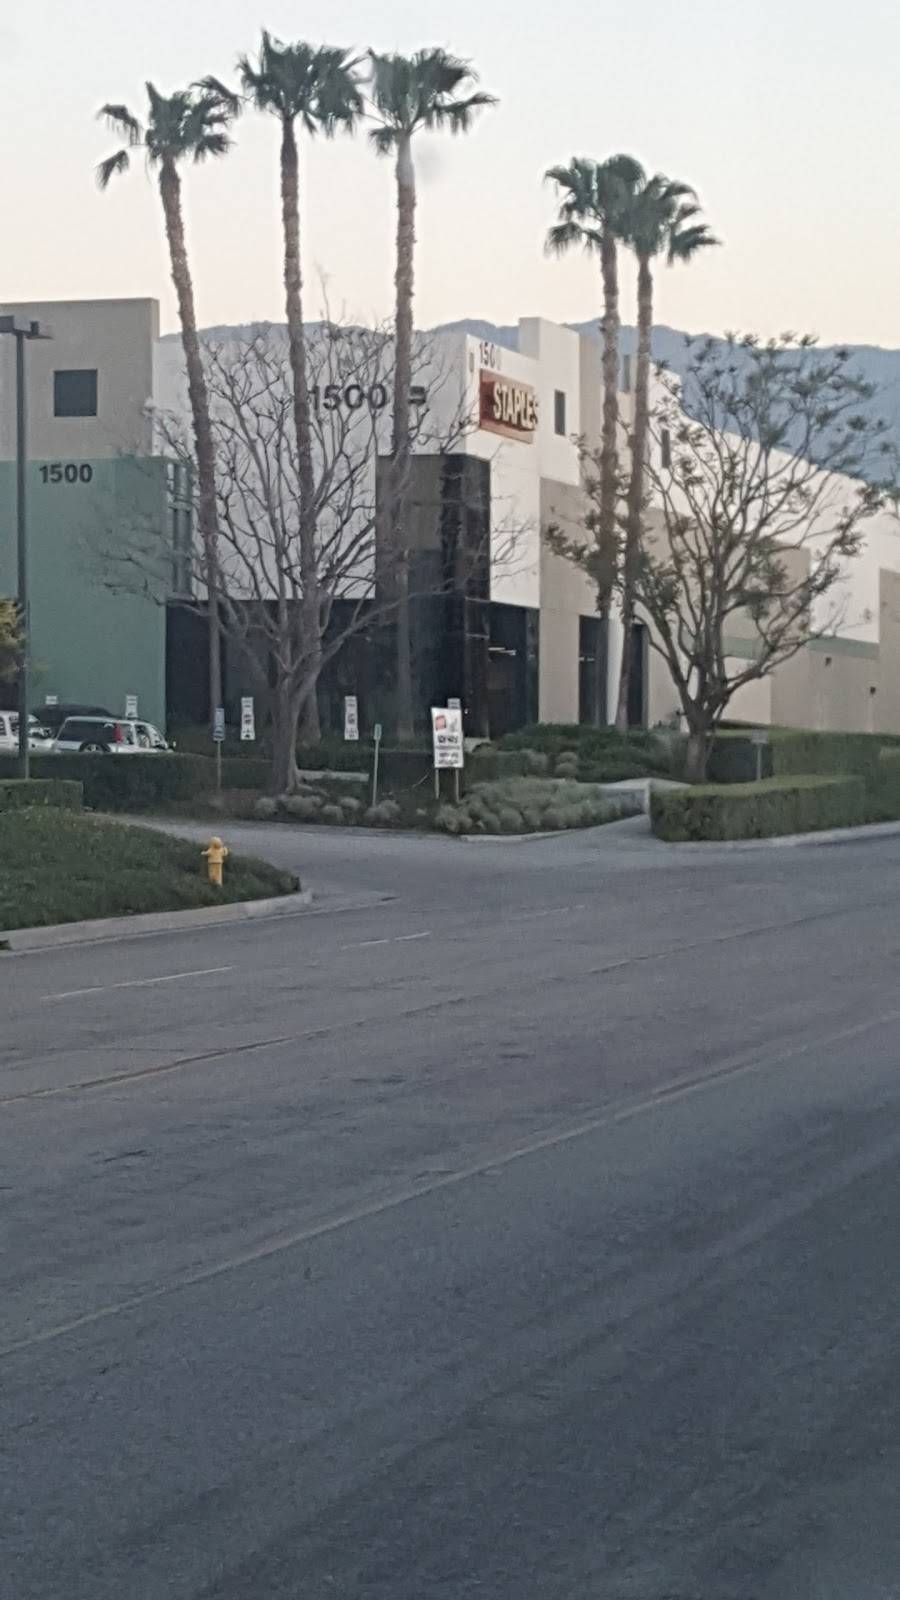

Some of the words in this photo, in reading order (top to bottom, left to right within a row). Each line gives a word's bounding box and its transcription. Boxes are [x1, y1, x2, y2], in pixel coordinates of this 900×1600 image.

[311, 384, 386, 410] 1500
[493, 381, 538, 430] STAPLES
[39, 463, 93, 484] 1500
